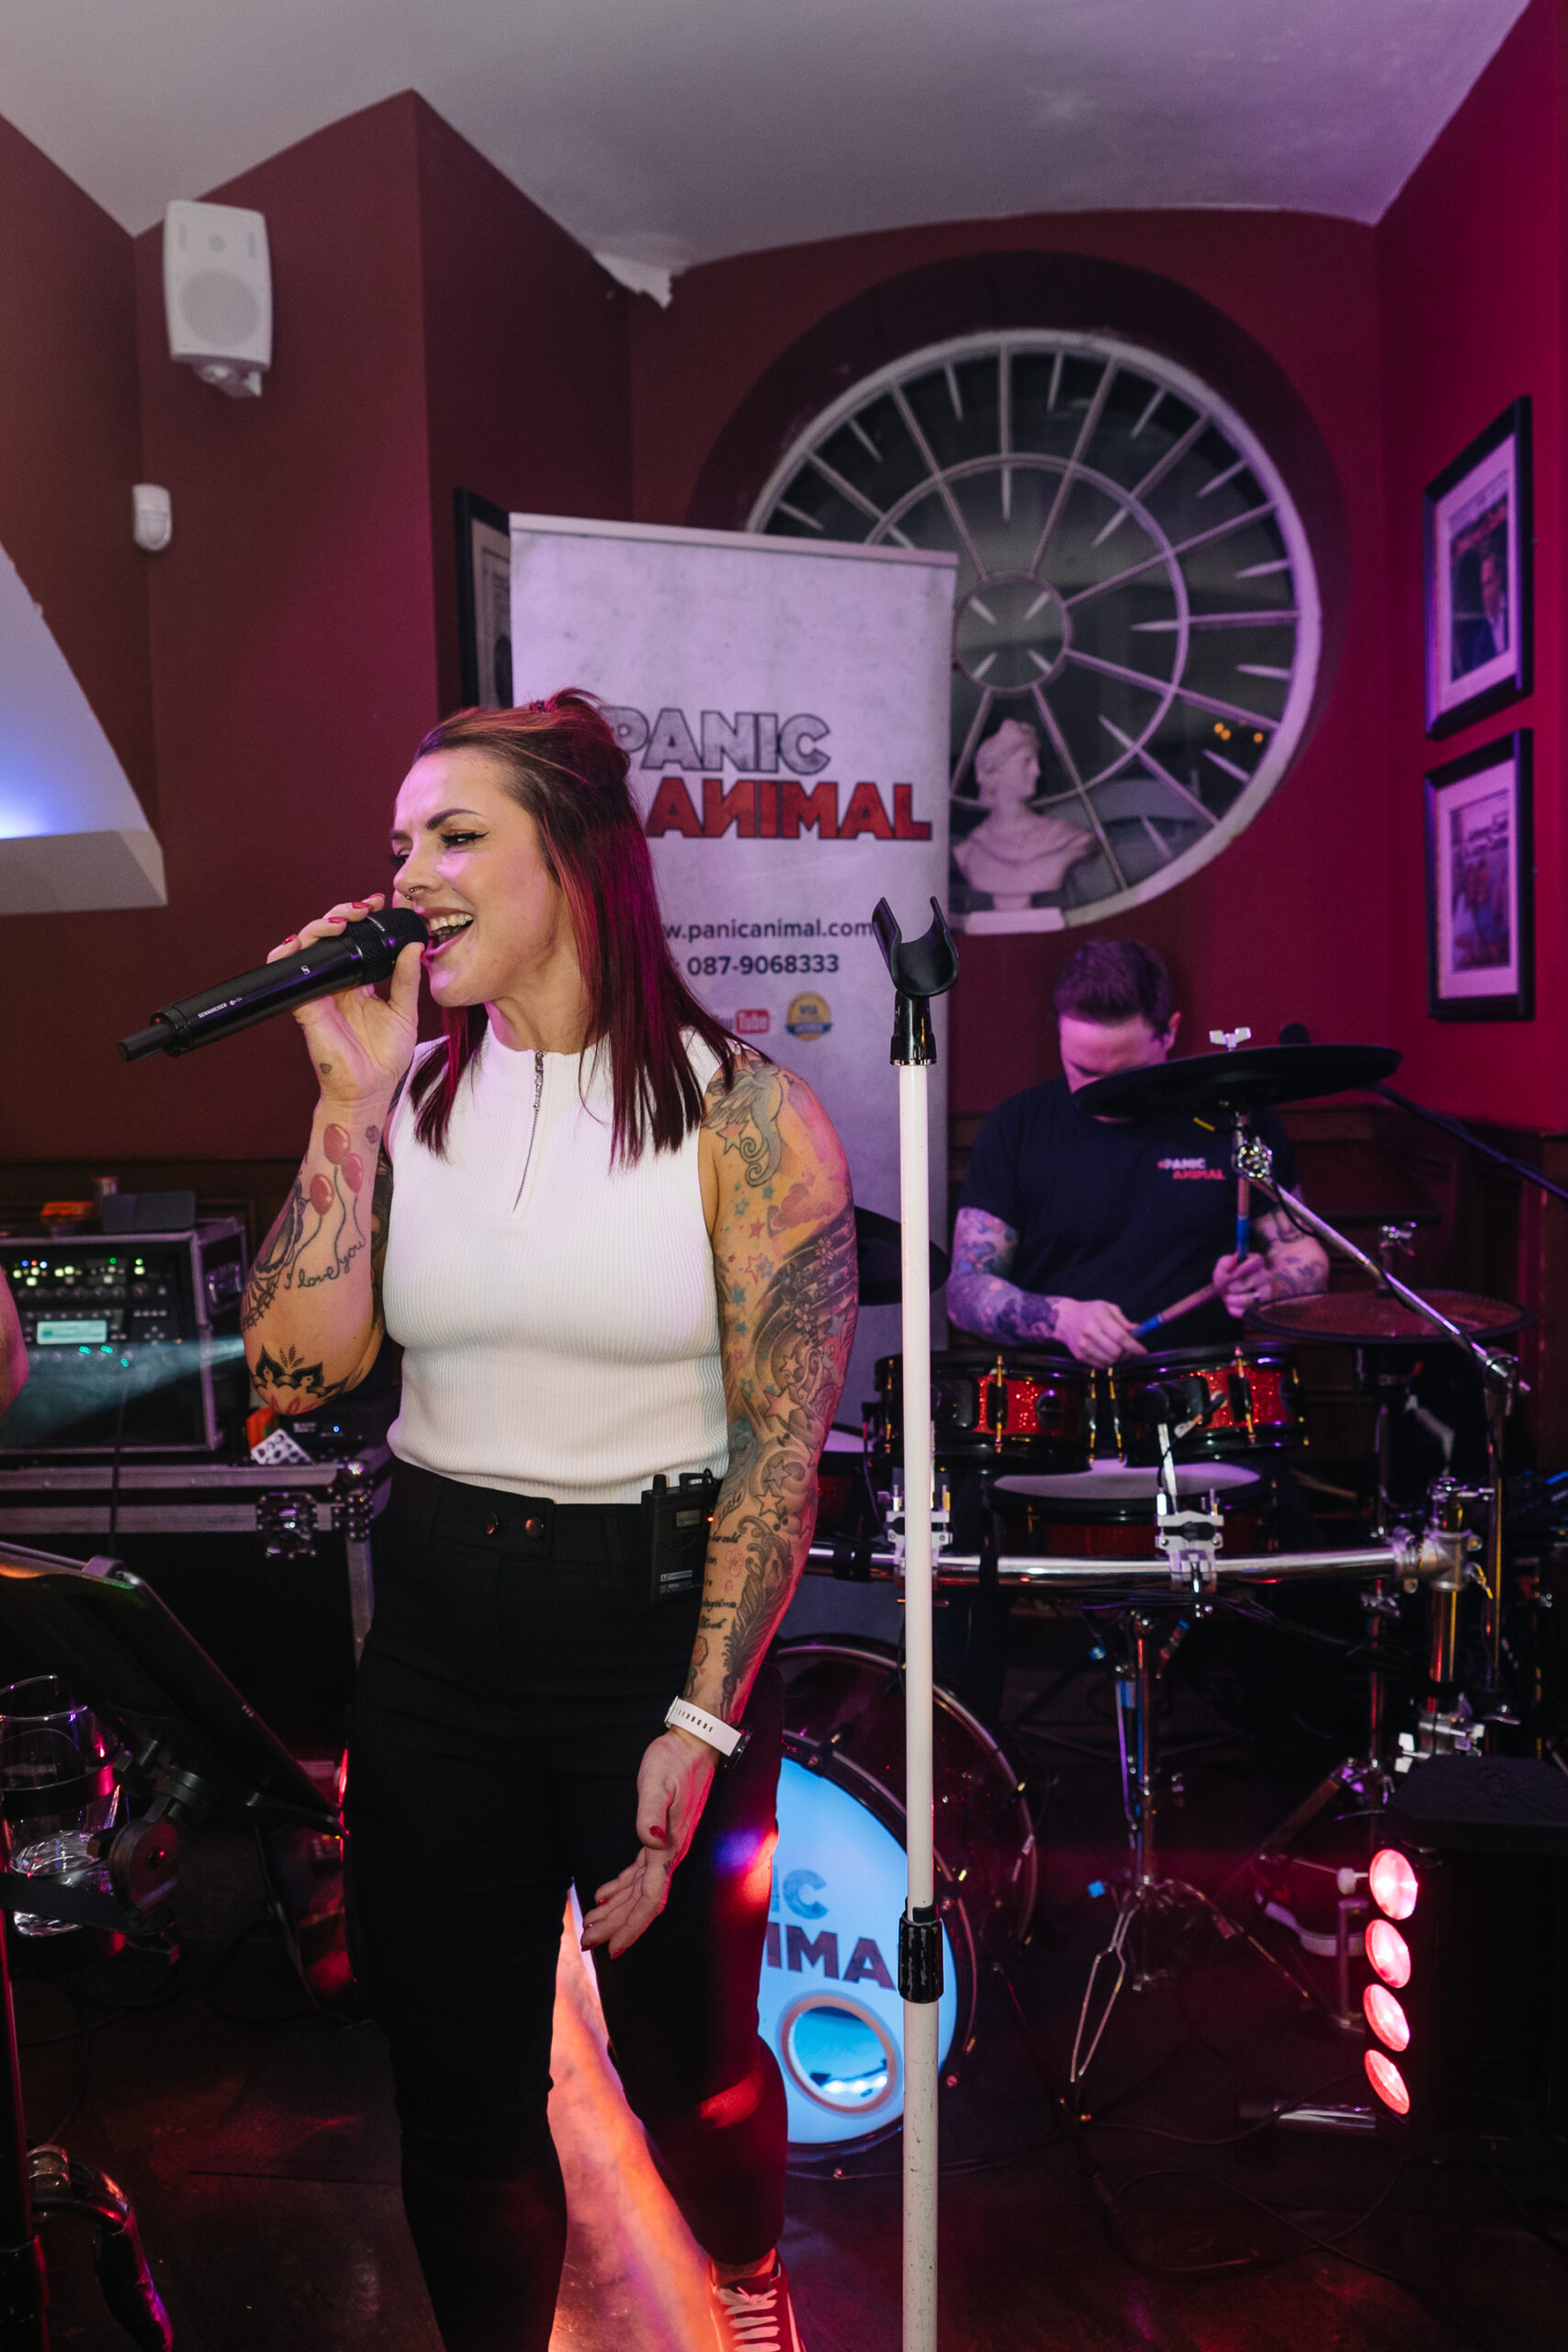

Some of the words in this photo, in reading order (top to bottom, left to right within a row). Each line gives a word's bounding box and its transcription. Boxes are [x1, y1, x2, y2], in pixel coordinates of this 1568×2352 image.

[600, 706, 831, 776] PANIC
[643, 776, 932, 842] ANIMAL
[687, 954, 840, 976] 087-9068333
[1164, 1158, 1206, 1170] PANIC
[1172, 1169, 1226, 1180] ANIMAL
